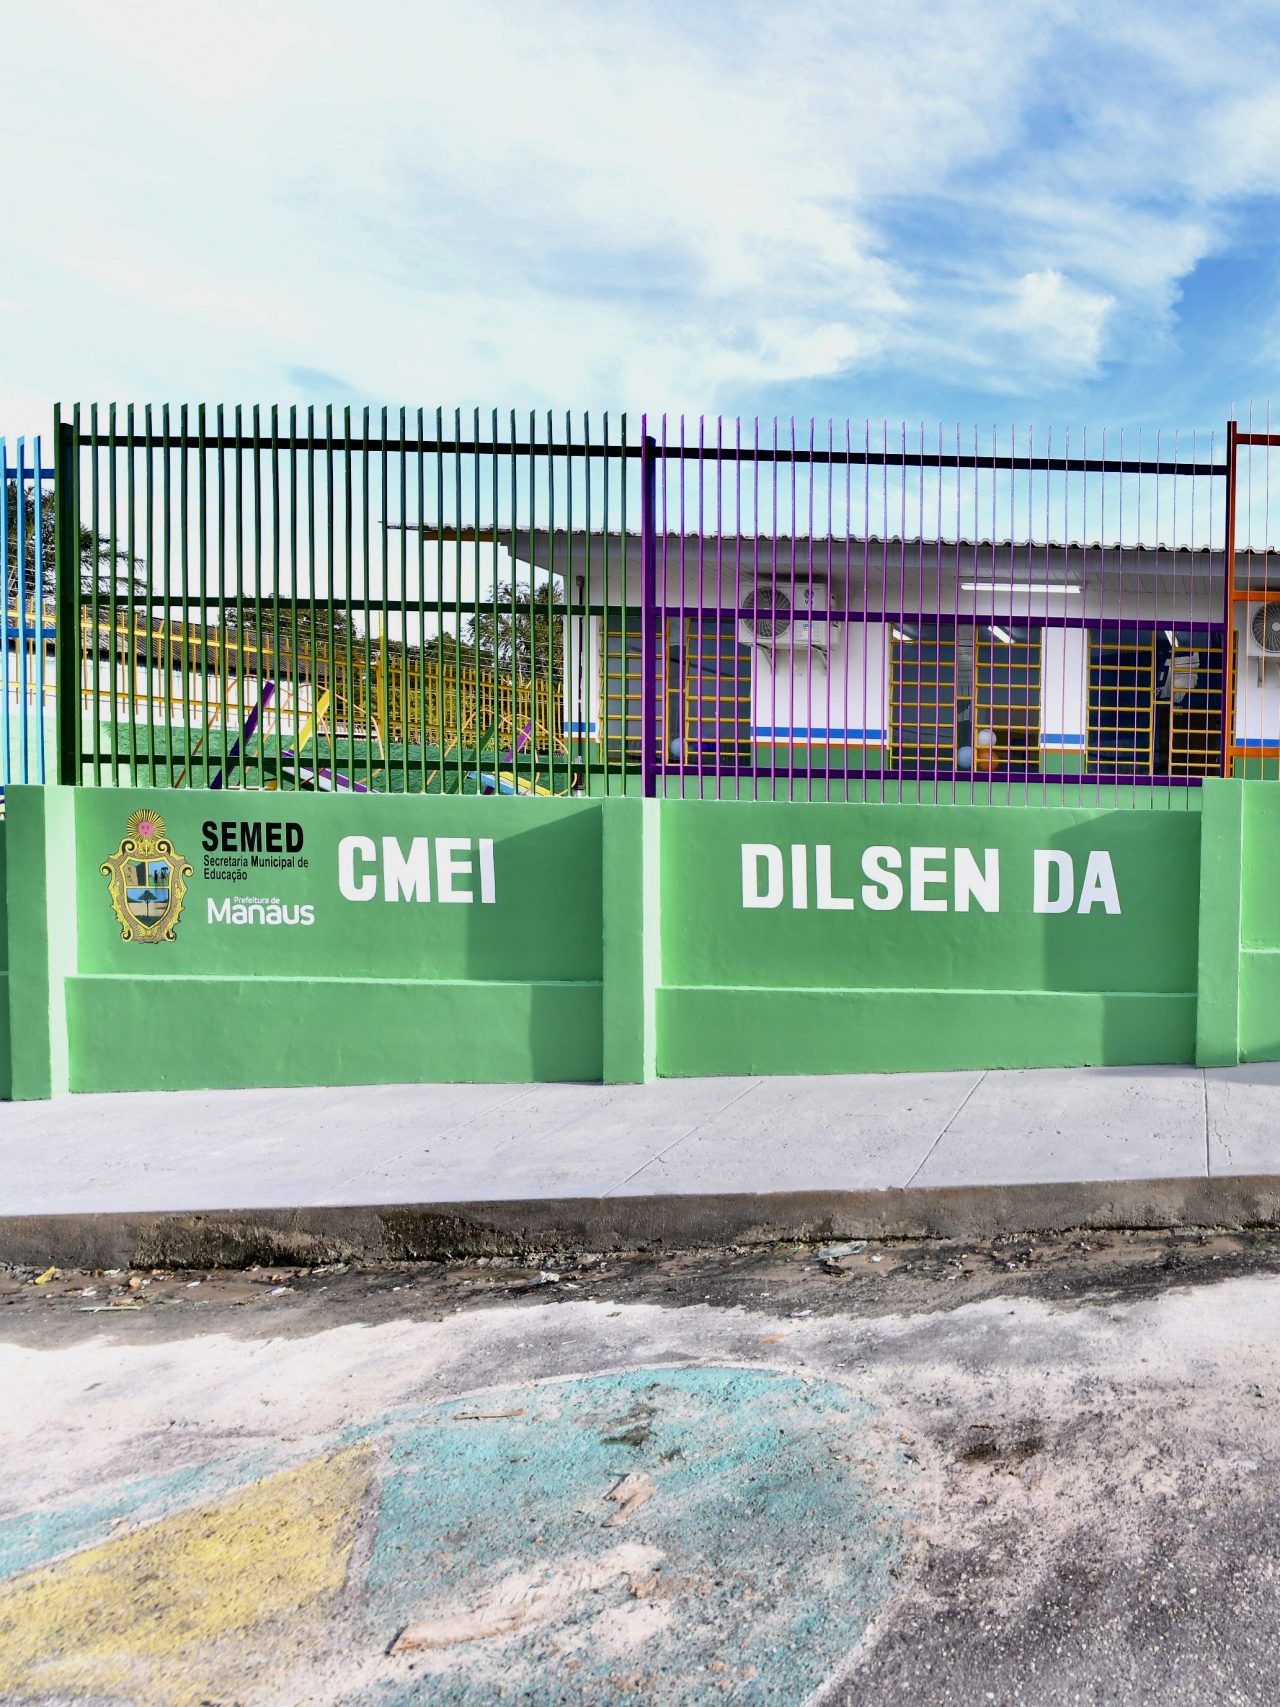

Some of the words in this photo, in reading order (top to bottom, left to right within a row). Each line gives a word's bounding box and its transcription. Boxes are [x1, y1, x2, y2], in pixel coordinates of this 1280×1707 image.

[202, 821, 304, 853] SEMED
[203, 855, 248, 868] Secretaria
[251, 855, 295, 870] Municipal
[297, 856, 309, 868] de
[203, 868, 248, 883] Educação
[338, 835, 496, 904] CMEI
[741, 843, 1000, 913] DILSEN
[1032, 849, 1122, 915] DA
[207, 897, 316, 926] Manaus
[233, 896, 270, 905] Prefeitura
[270, 896, 281, 905] de
